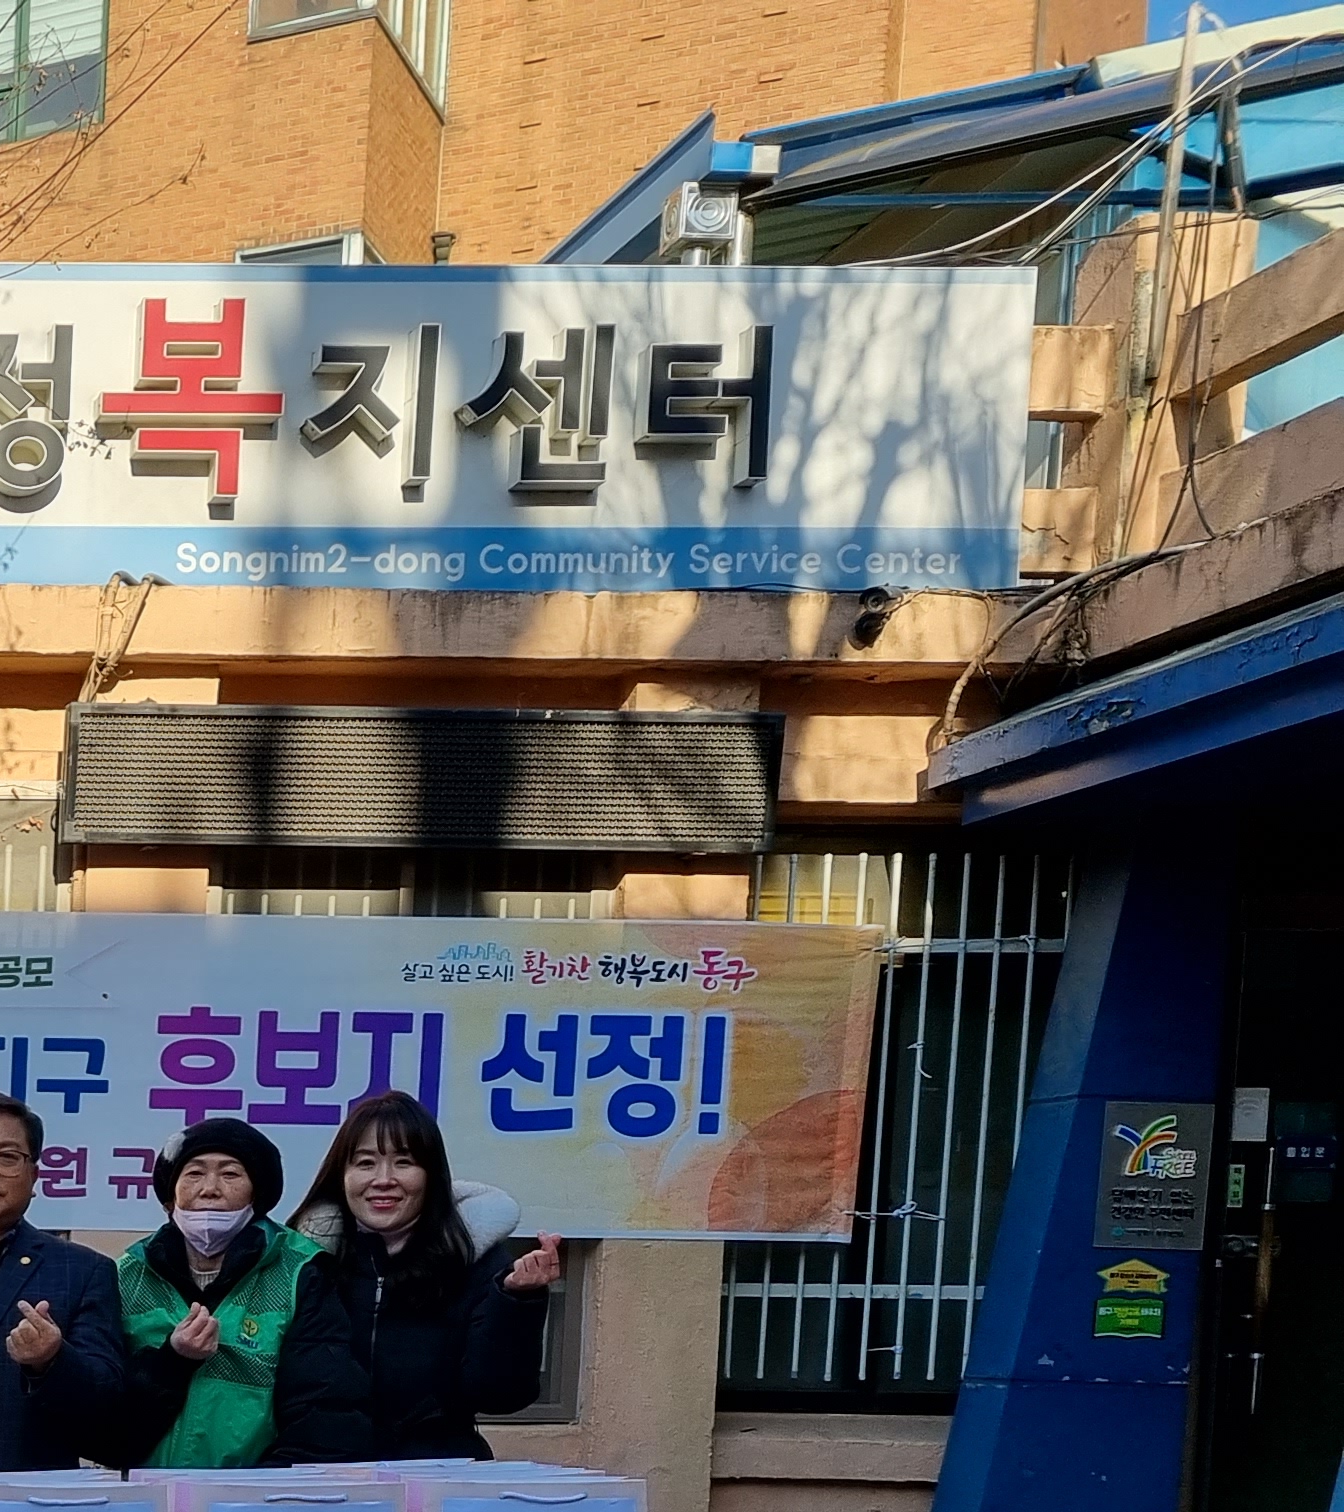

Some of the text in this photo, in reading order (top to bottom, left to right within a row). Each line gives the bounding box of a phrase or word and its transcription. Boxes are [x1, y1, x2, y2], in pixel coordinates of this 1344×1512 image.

[176, 543, 961, 581] Songnim2-dong Community Service Center
[401, 963, 434, 982] 살고
[438, 963, 472, 983] 싶은
[521, 950, 590, 985] 활기찬
[598, 953, 689, 988] 행복도시
[692, 950, 755, 990] 동구
[149, 1006, 444, 1127] 후보지
[481, 1012, 727, 1137] 선정!
[108, 1147, 154, 1200] 규
